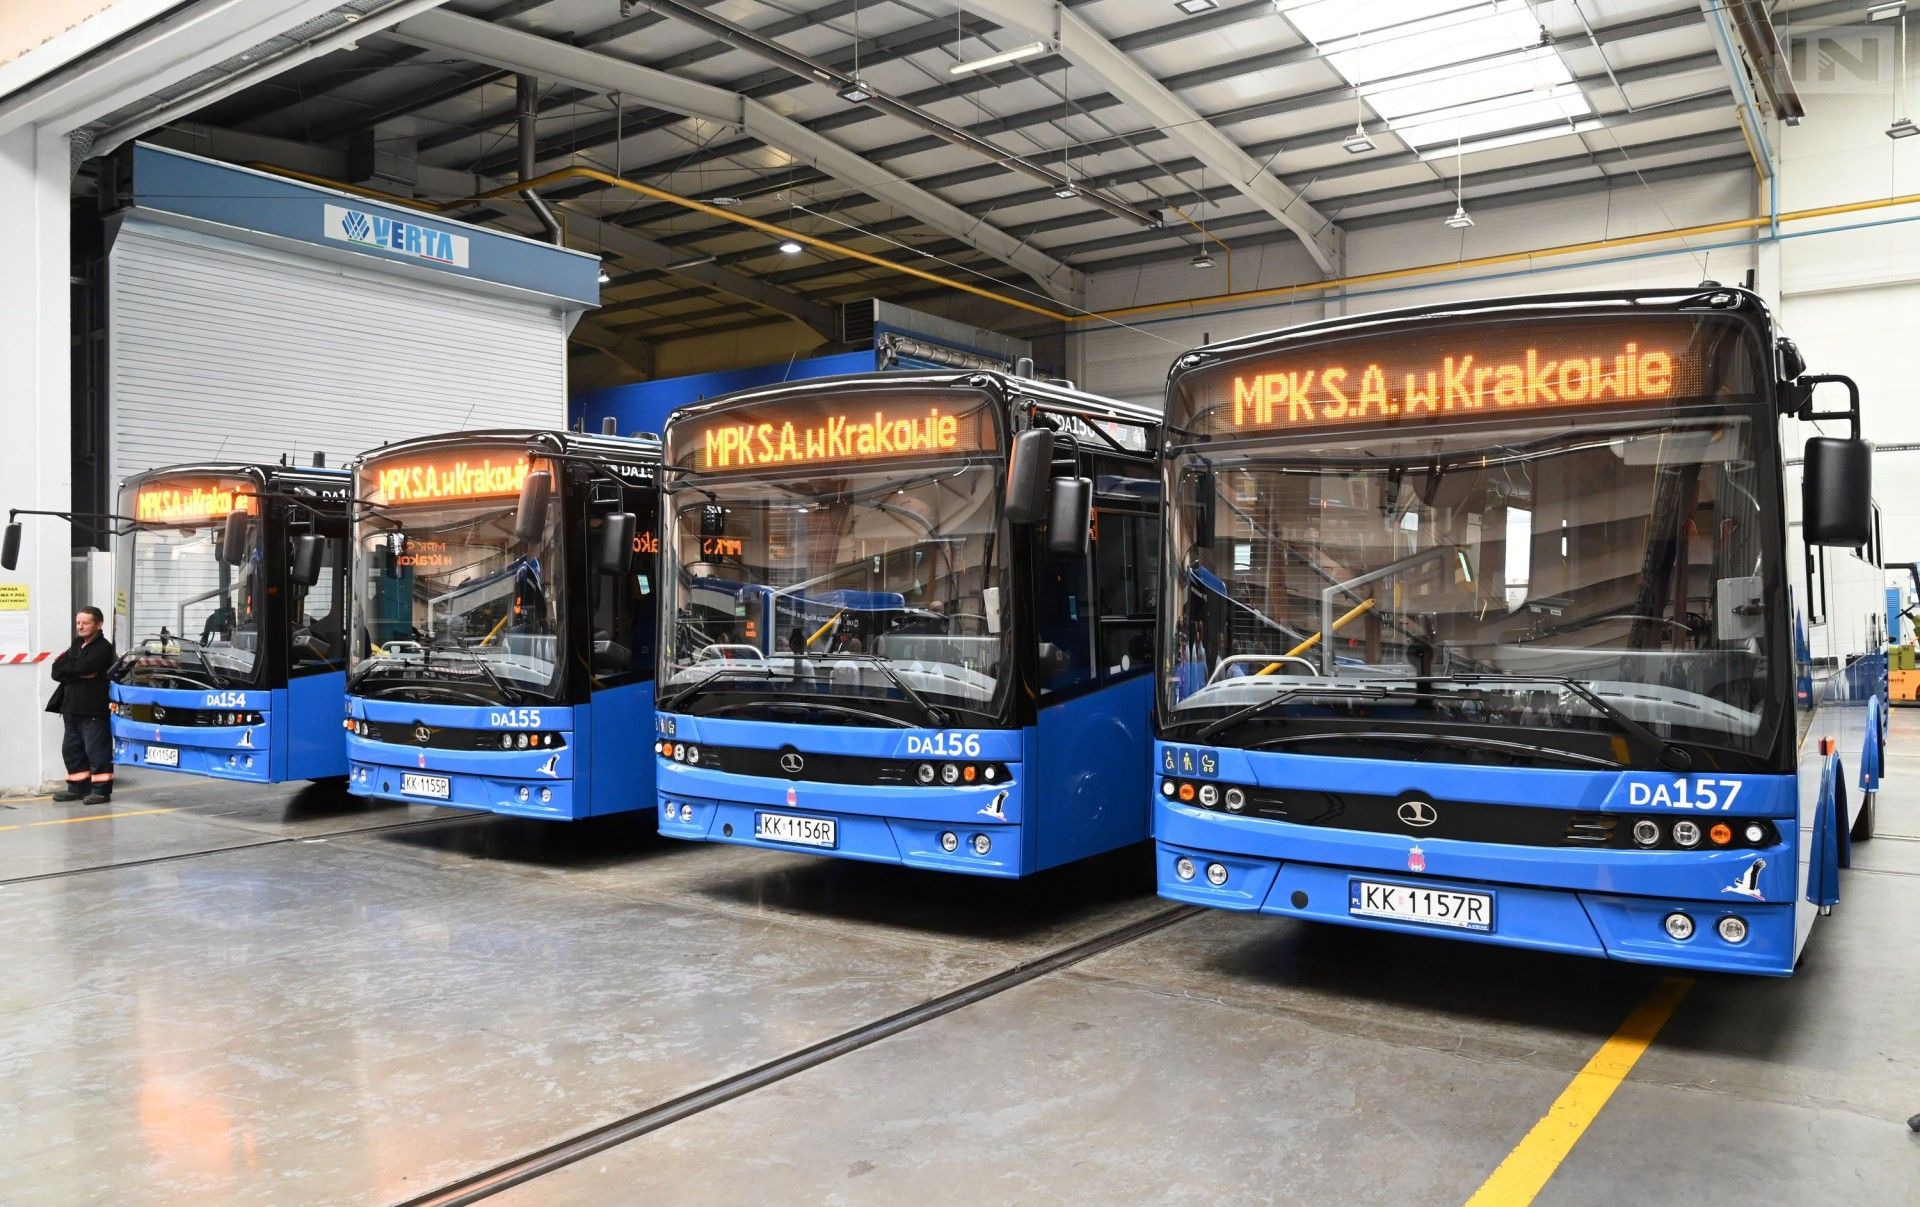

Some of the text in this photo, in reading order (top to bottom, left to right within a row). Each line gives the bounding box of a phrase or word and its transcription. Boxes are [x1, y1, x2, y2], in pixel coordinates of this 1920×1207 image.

[372, 216, 454, 261] VERTA
[1234, 343, 1672, 425] MPK S.A. w Krakowie
[706, 408, 957, 468] MPK S.A. w Krakowie
[379, 458, 529, 500] MPK S.A. w Krakowi
[621, 461, 661, 479] DA15
[139, 491, 161, 519] MPK
[322, 489, 351, 503] DA1
[207, 692, 246, 708] DA154
[491, 709, 541, 728] DA155
[907, 732, 980, 757] DA156
[406, 776, 447, 794] KK 1155R
[1629, 778, 1743, 811] DA157
[764, 816, 831, 841] KK 1156R
[1367, 886, 1396, 911] KK
[1408, 891, 1482, 922] 1157R
